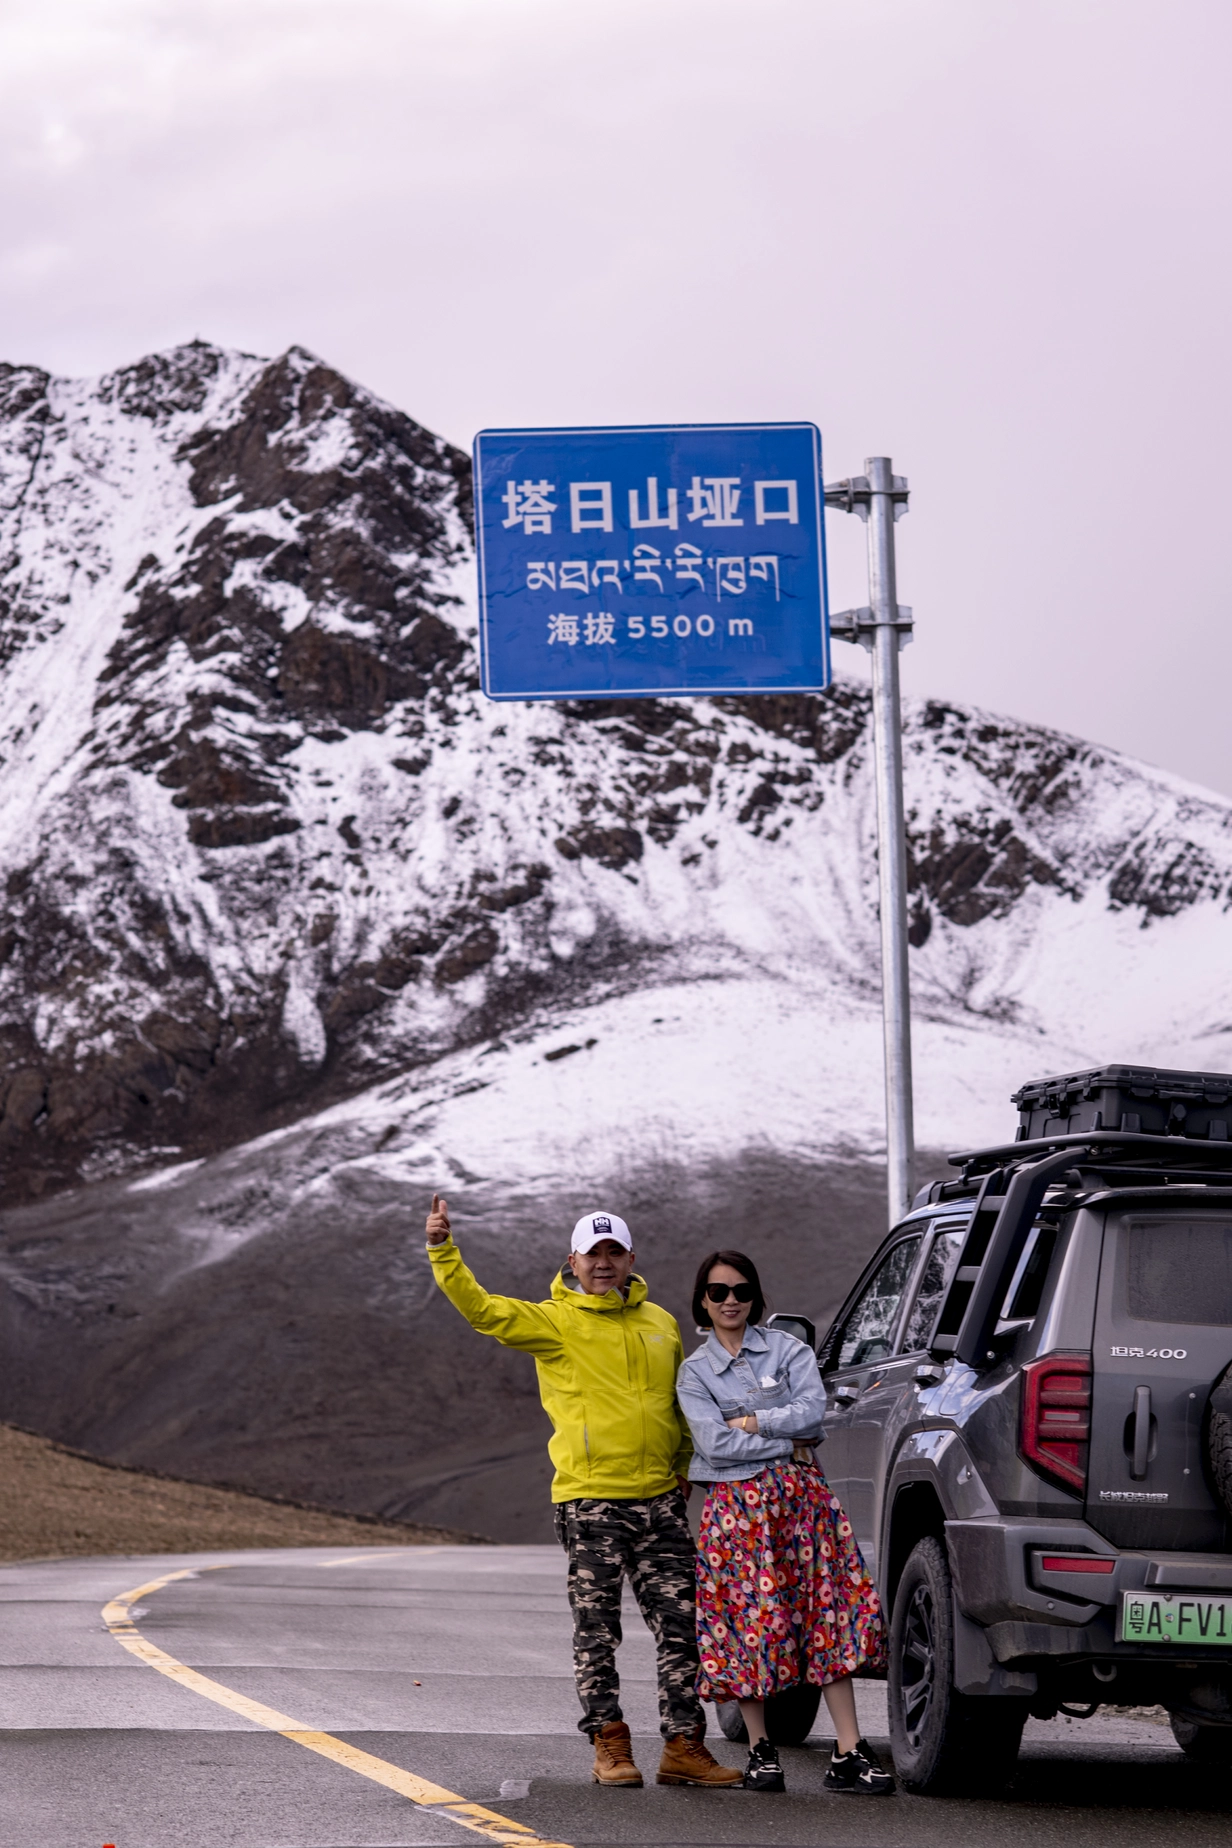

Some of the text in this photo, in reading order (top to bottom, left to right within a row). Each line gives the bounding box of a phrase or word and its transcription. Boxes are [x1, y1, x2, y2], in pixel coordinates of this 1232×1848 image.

[501, 477, 800, 534] 塔日山垭口
[547, 612, 617, 646] 海拔
[627, 614, 715, 639] 5500
[728, 618, 754, 636] m
[1178, 1602, 1232, 1637] FV1
